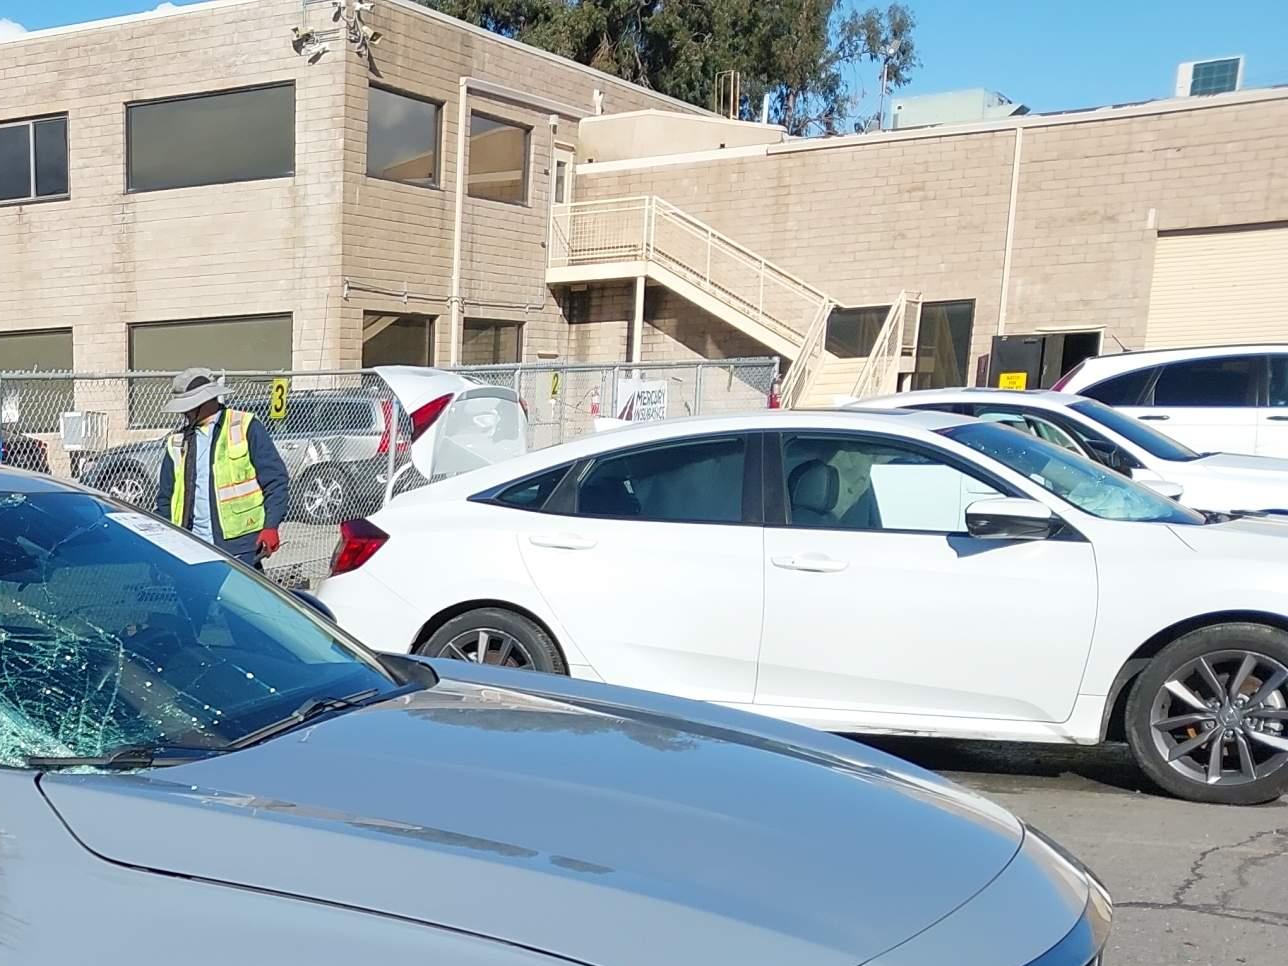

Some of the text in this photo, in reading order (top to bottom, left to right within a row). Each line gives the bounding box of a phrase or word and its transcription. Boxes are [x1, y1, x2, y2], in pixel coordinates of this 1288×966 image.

[551, 373, 559, 395] 2
[274, 384, 284, 413] 3
[636, 389, 665, 406] MERCURY
[634, 406, 665, 421] INSURANCE
